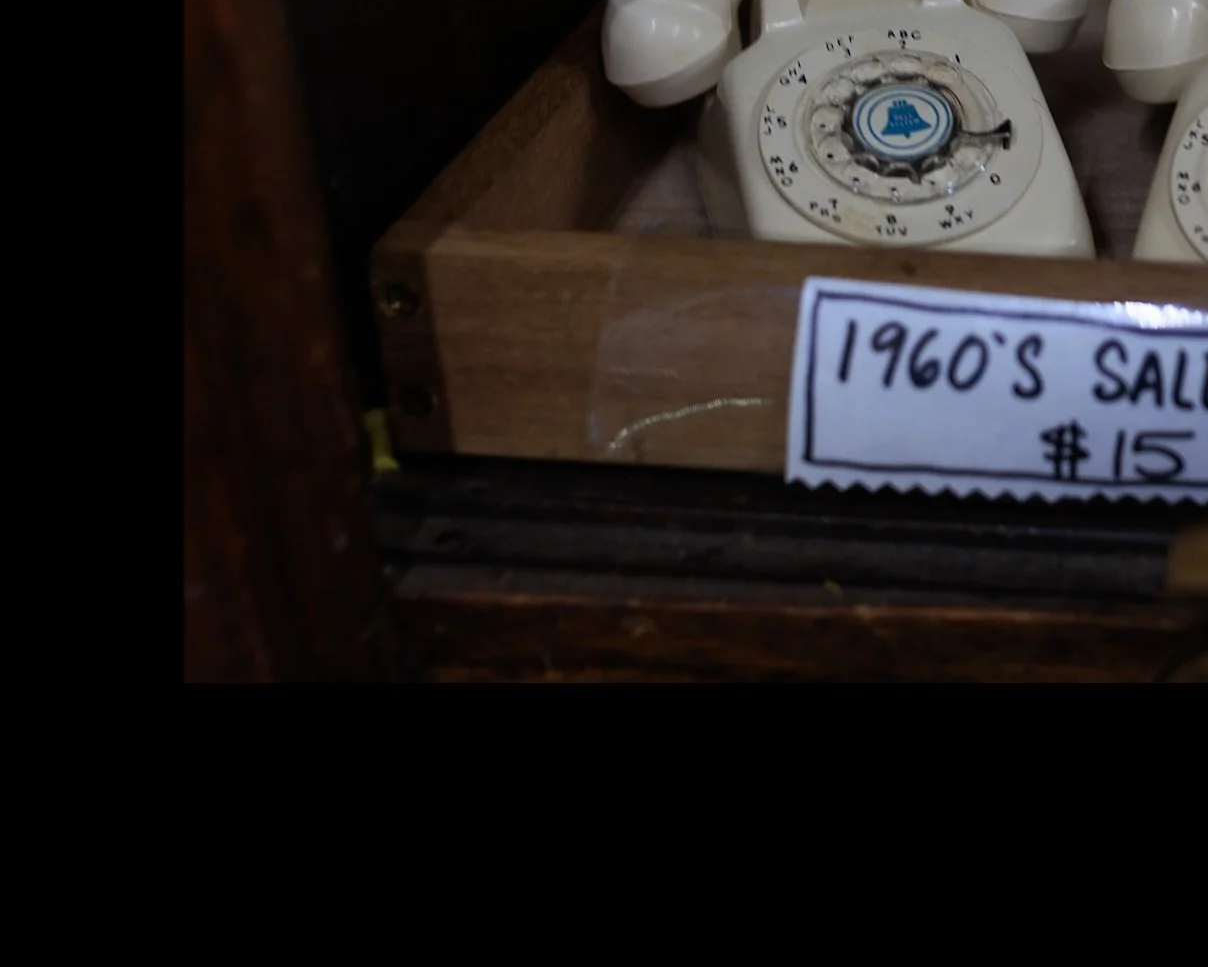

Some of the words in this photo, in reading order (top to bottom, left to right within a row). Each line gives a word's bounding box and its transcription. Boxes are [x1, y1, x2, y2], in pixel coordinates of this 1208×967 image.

[887, 29, 922, 41] ABC
[937, 208, 975, 231] WXY
[837, 319, 1043, 401] 1960'S
